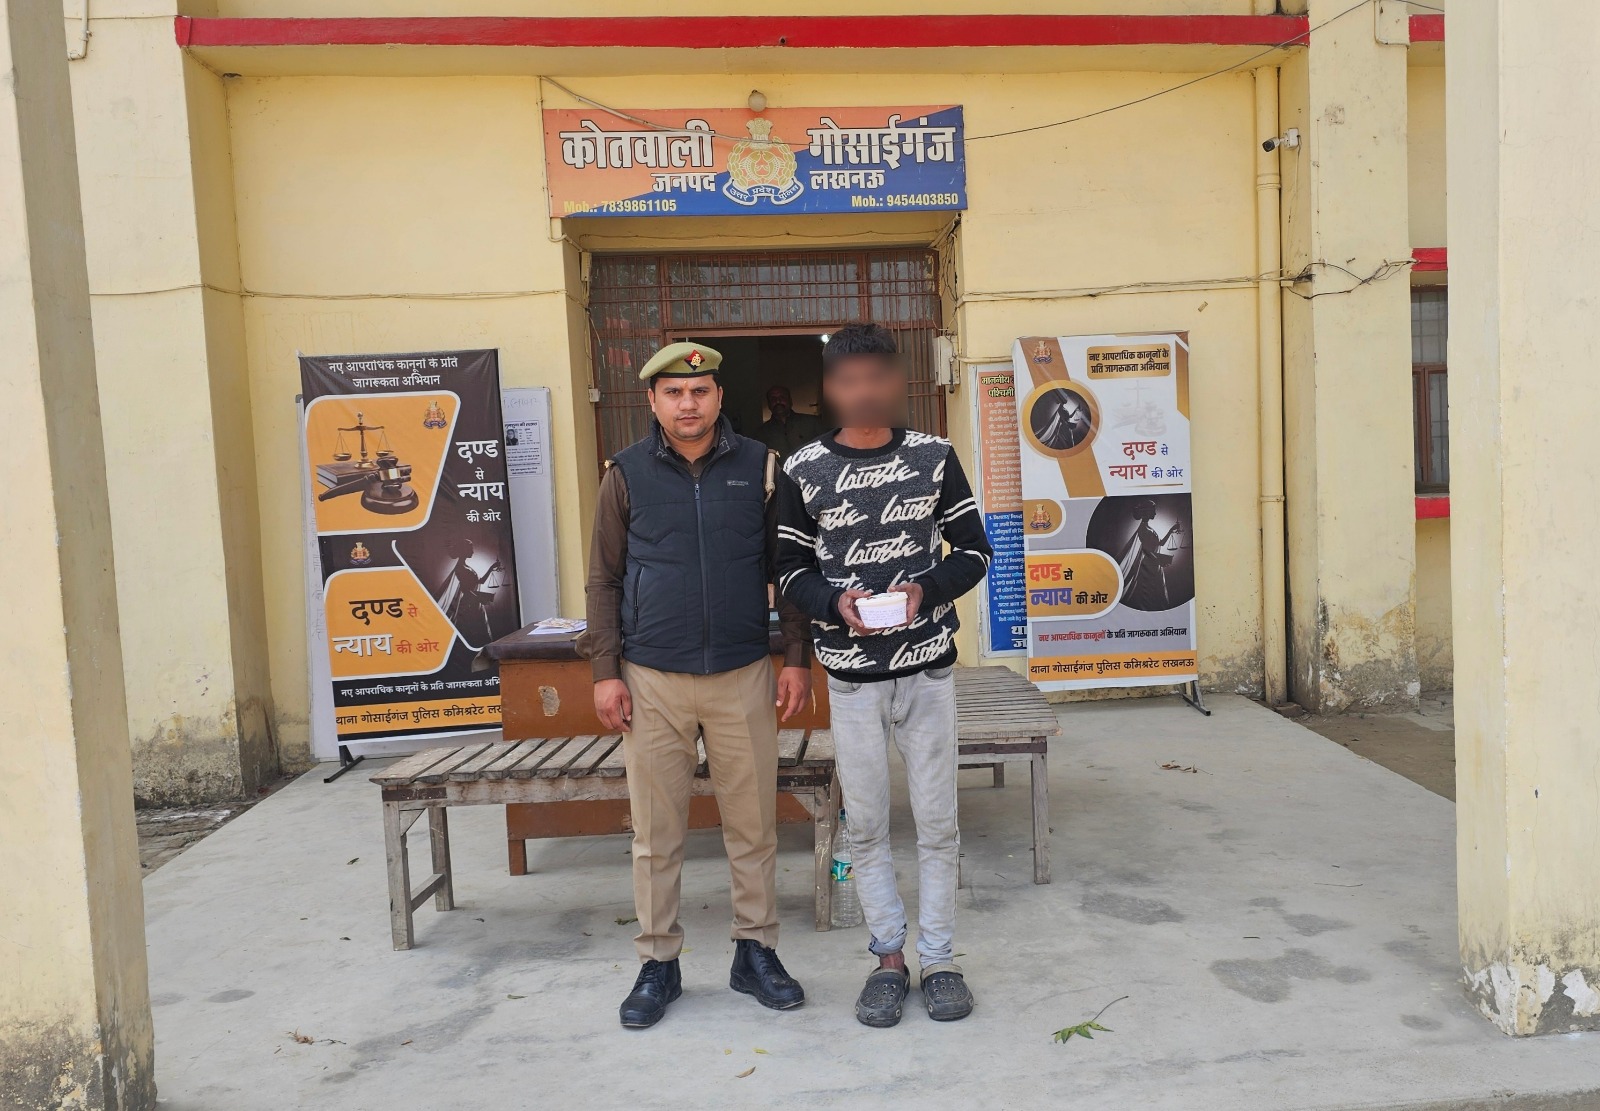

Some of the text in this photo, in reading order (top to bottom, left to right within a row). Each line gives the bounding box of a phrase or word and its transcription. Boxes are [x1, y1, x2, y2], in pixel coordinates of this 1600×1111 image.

[559, 119, 715, 169] कोतवाली
[807, 114, 956, 170] गोसाईगंज
[651, 172, 717, 192] जनपद
[809, 169, 885, 190] लखनऊ
[751, 185, 775, 195] प्रदेश
[563, 199, 677, 213] Mob.: 7839861105
[851, 193, 959, 208] Mob.: 9454403850
[1088, 348, 1170, 362] नए आपराधिक कानूनों के
[328, 362, 344, 374] नए
[1090, 364, 1104, 374] प्रति
[1140, 360, 1170, 372] अभियान
[401, 373, 441, 386] अभियान
[981, 375, 1010, 385] माननीय
[455, 439, 499, 464] दण्ड
[1122, 441, 1169, 460] दण्ड से
[474, 467, 484, 480] से
[1109, 464, 1184, 480] न्याय की ओर
[457, 482, 505, 501] न्याय
[466, 508, 502, 522] की ओर
[1028, 563, 1074, 582] दण्ड से
[1029, 587, 1073, 606] न्याय
[1075, 592, 1089, 605] की
[1090, 591, 1109, 604] ओर
[349, 598, 419, 626] दण्ड से
[1038, 634, 1049, 642] नए
[1051, 630, 1083, 642] आपराधिक
[1083, 629, 1106, 642] कानूनों
[1106, 629, 1114, 639] के
[1114, 628, 1126, 639] प्रति
[1160, 626, 1187, 637] अभियान
[331, 633, 440, 657] न्याय की ओर
[1030, 664, 1050, 674] थाना
[1052, 659, 1094, 674] गोसाईगंज
[1096, 659, 1121, 675] पुलिस
[1162, 658, 1195, 669] लखनऊ
[341, 689, 353, 698] नए
[354, 684, 394, 696] आपराधिक
[395, 681, 419, 694] कानूनों
[420, 681, 429, 691] के
[430, 680, 444, 691] प्रति
[484, 676, 501, 687] अभि
[361, 708, 409, 724] गोसाईगंज
[412, 706, 440, 724] पुलिस
